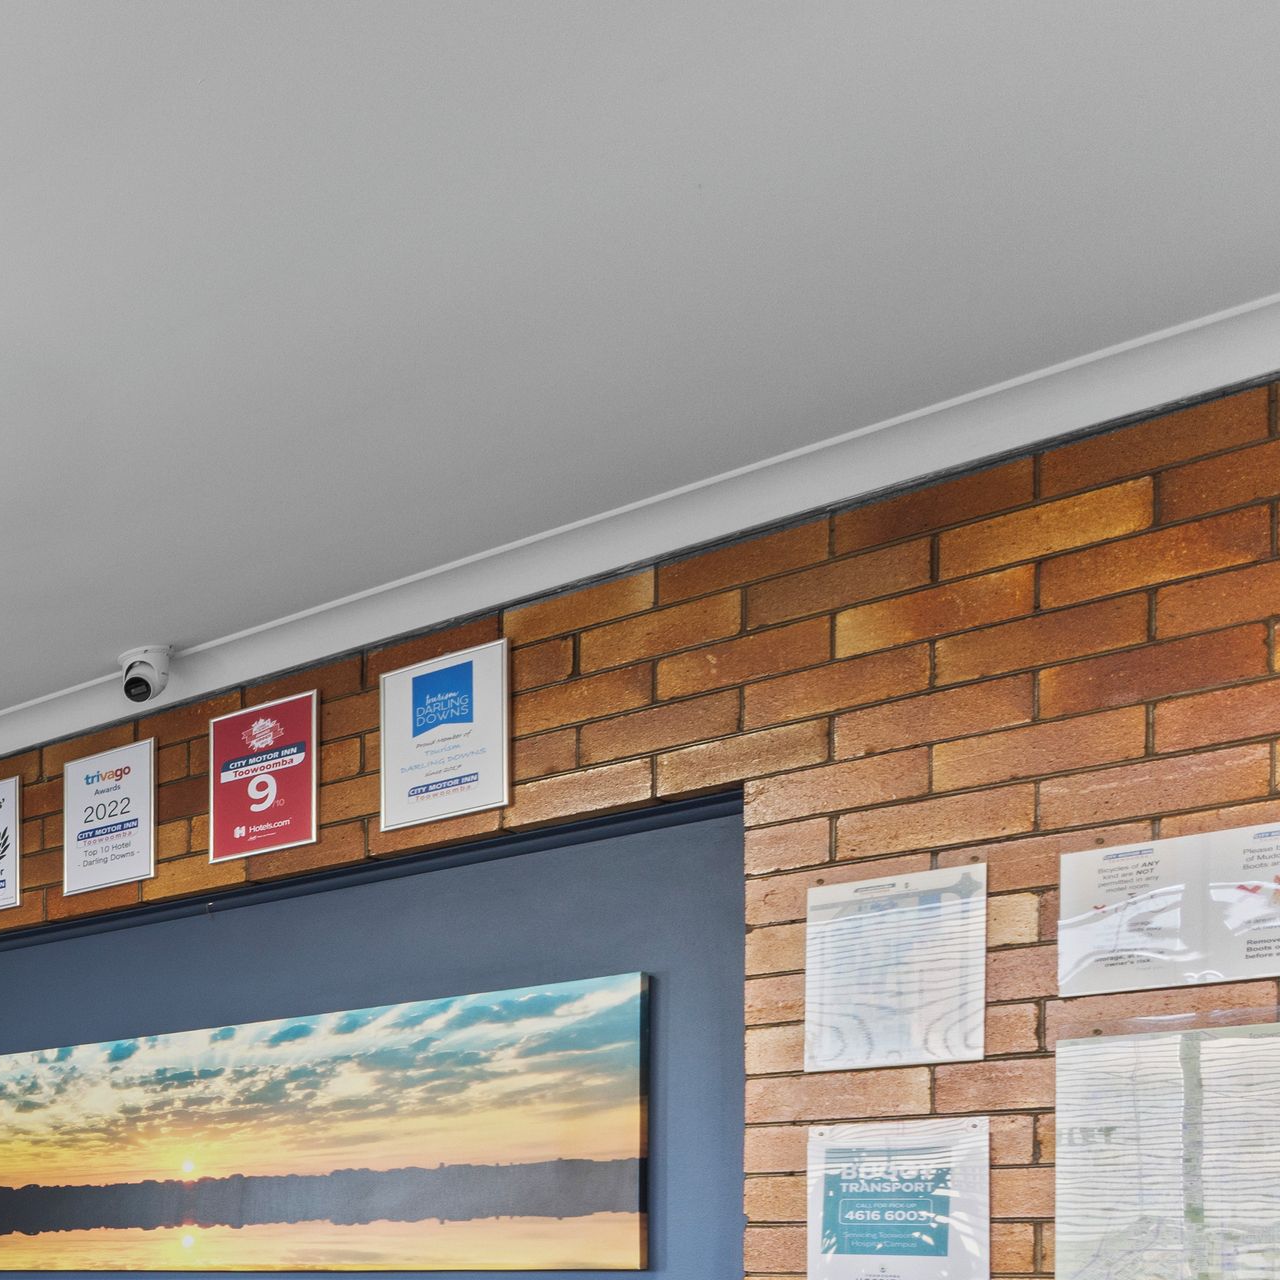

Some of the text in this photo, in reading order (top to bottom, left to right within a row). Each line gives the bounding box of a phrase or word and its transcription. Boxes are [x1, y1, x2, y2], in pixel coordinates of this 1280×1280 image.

[416, 694, 469, 717] DARLING
[416, 704, 469, 727] DOWNS
[229, 746, 298, 769] CITY MOTOR INN
[400, 759, 445, 774] DARLING
[83, 765, 131, 785] trivago
[232, 757, 294, 778] Toowoomba
[94, 784, 121, 796] Awards
[247, 773, 277, 813] 9
[409, 774, 478, 796] CITY MOTOR INN
[83, 797, 131, 824] 2022
[78, 820, 138, 840] CITY MOTOR INN
[248, 819, 291, 833] Hotels.com
[83, 831, 132, 847] Toowoomba
[83, 840, 132, 857] Top 10 Hotel
[82, 850, 135, 868] Darling Downs
[1141, 860, 1160, 868] ANY
[1135, 868, 1155, 876] NOT
[839, 1182, 936, 1193] TRANSPORT
[845, 1210, 881, 1221] 4616
